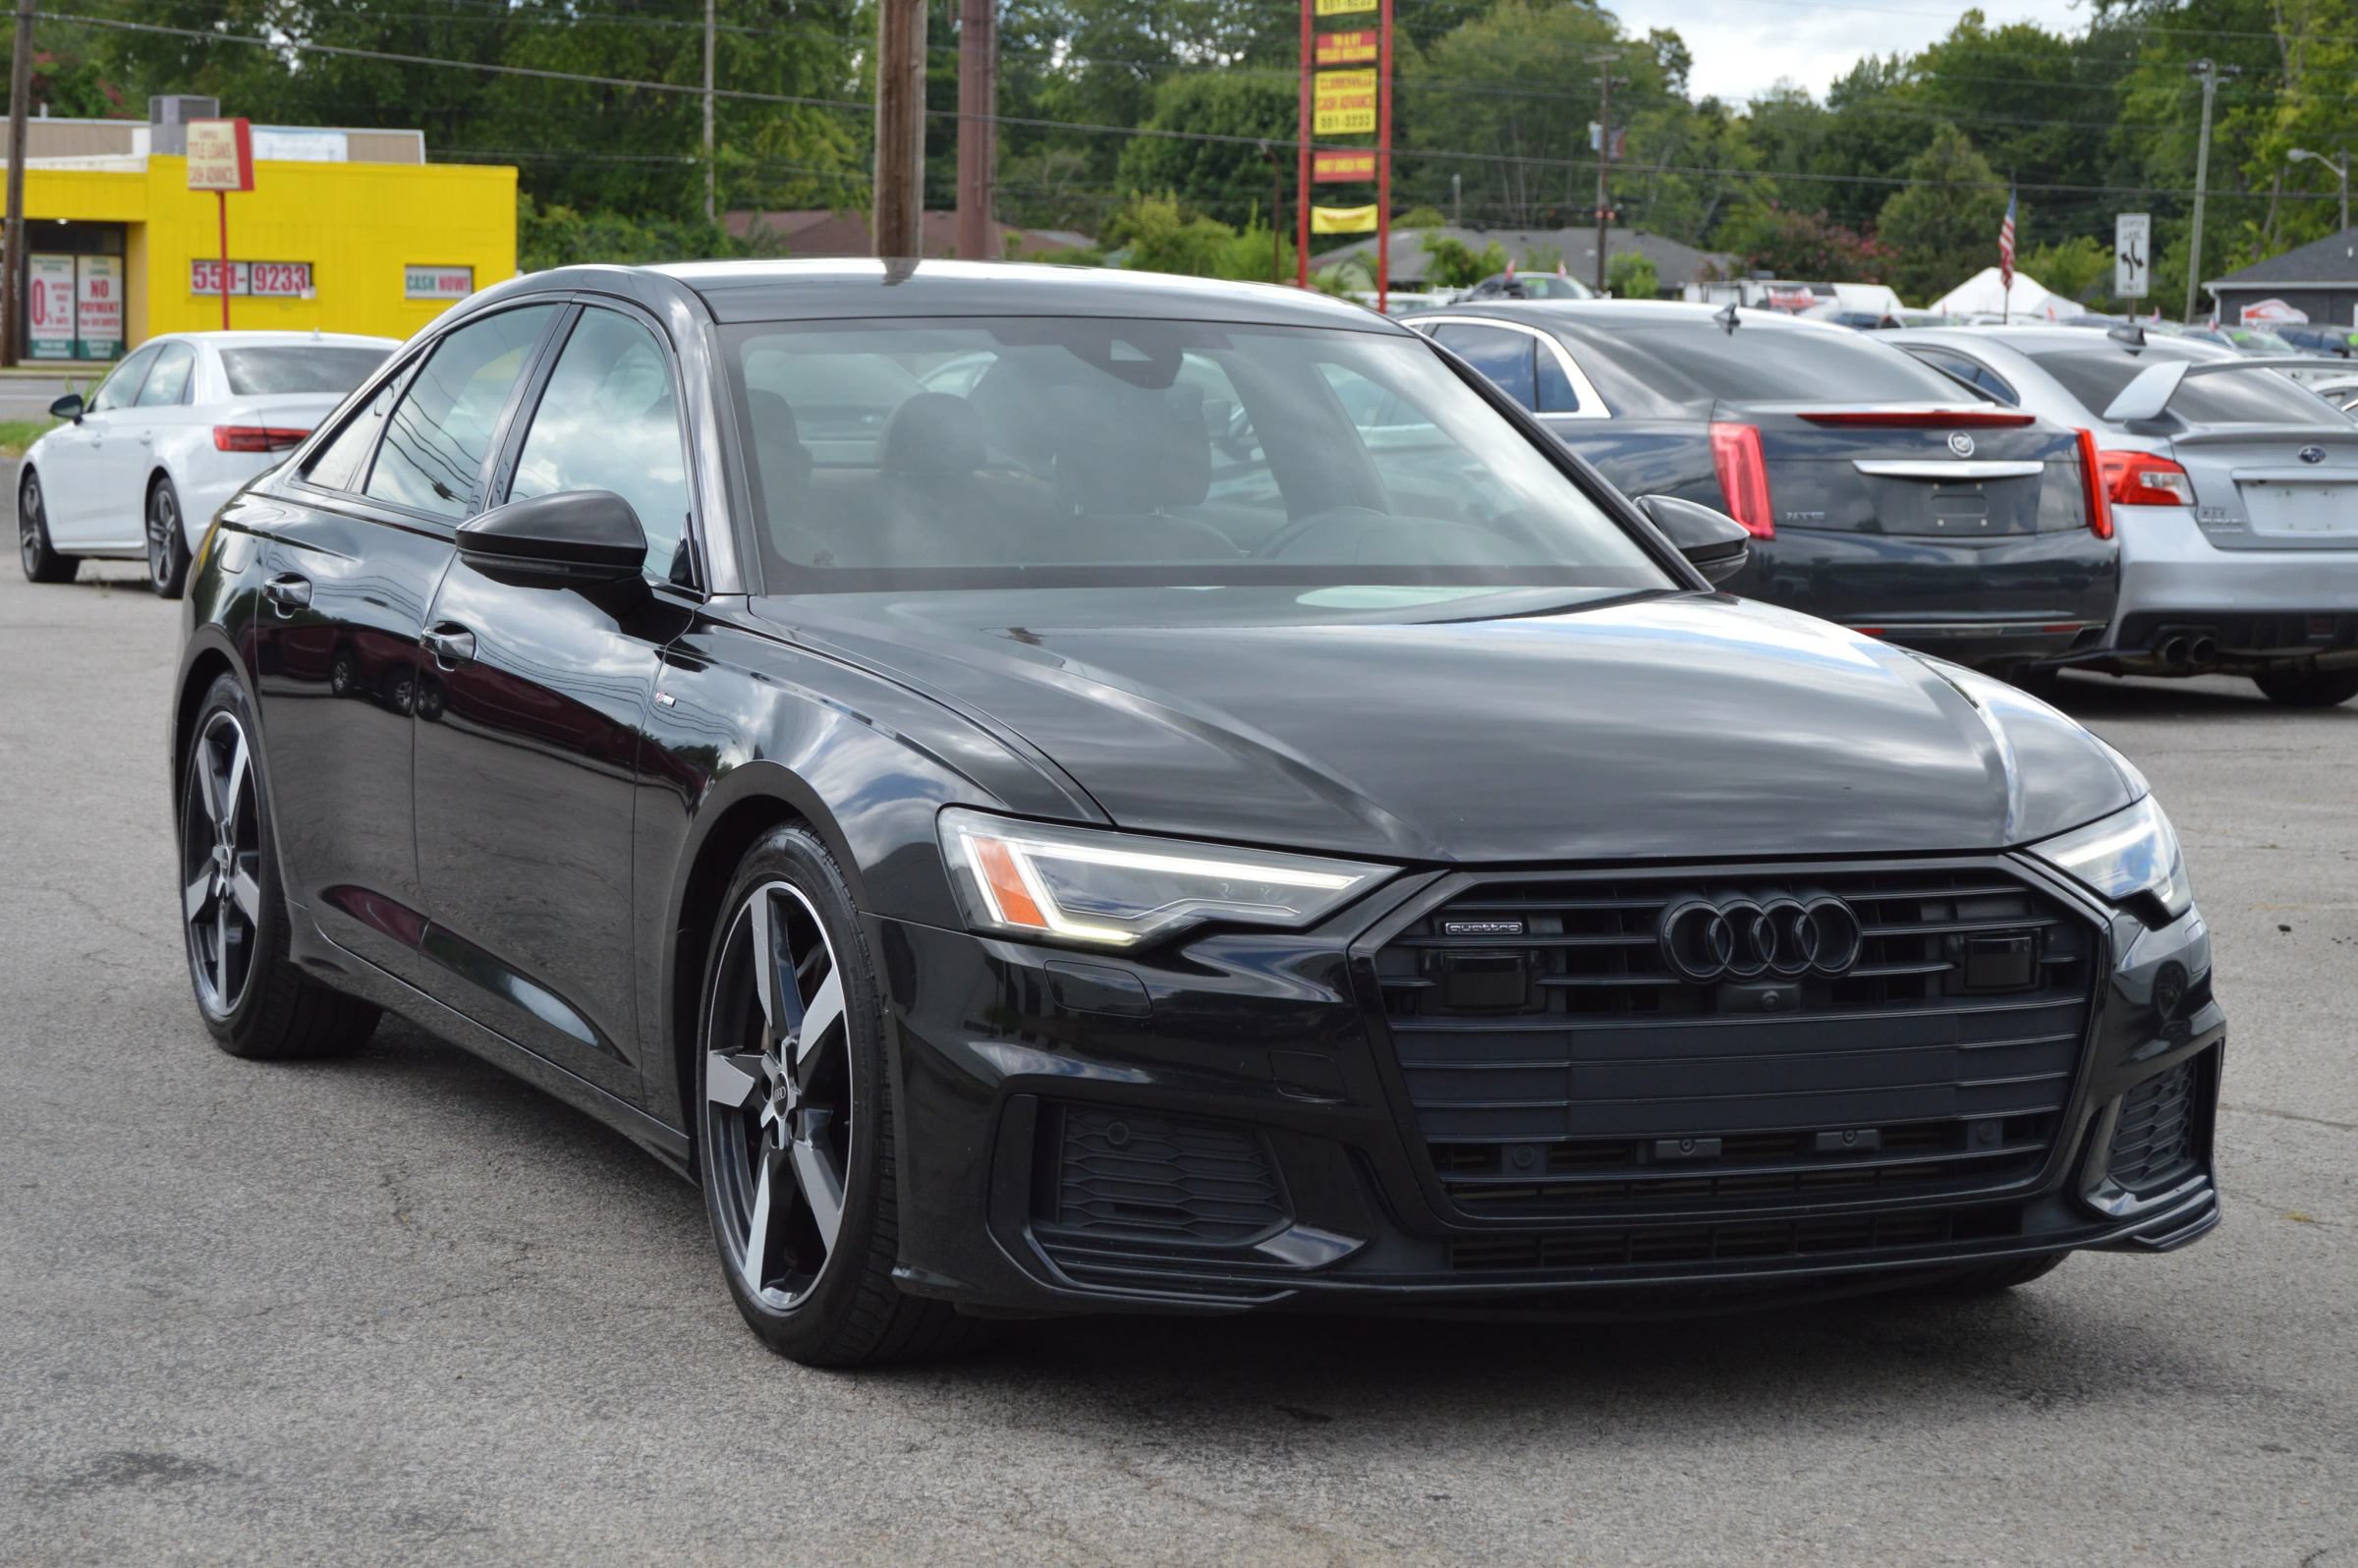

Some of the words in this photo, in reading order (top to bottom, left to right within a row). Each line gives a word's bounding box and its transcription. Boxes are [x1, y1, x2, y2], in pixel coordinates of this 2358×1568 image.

[90, 278, 109, 299] NO
[407, 275, 436, 291] CASH
[80, 301, 119, 313] PAYMENT
[1449, 924, 1520, 933] quattro
